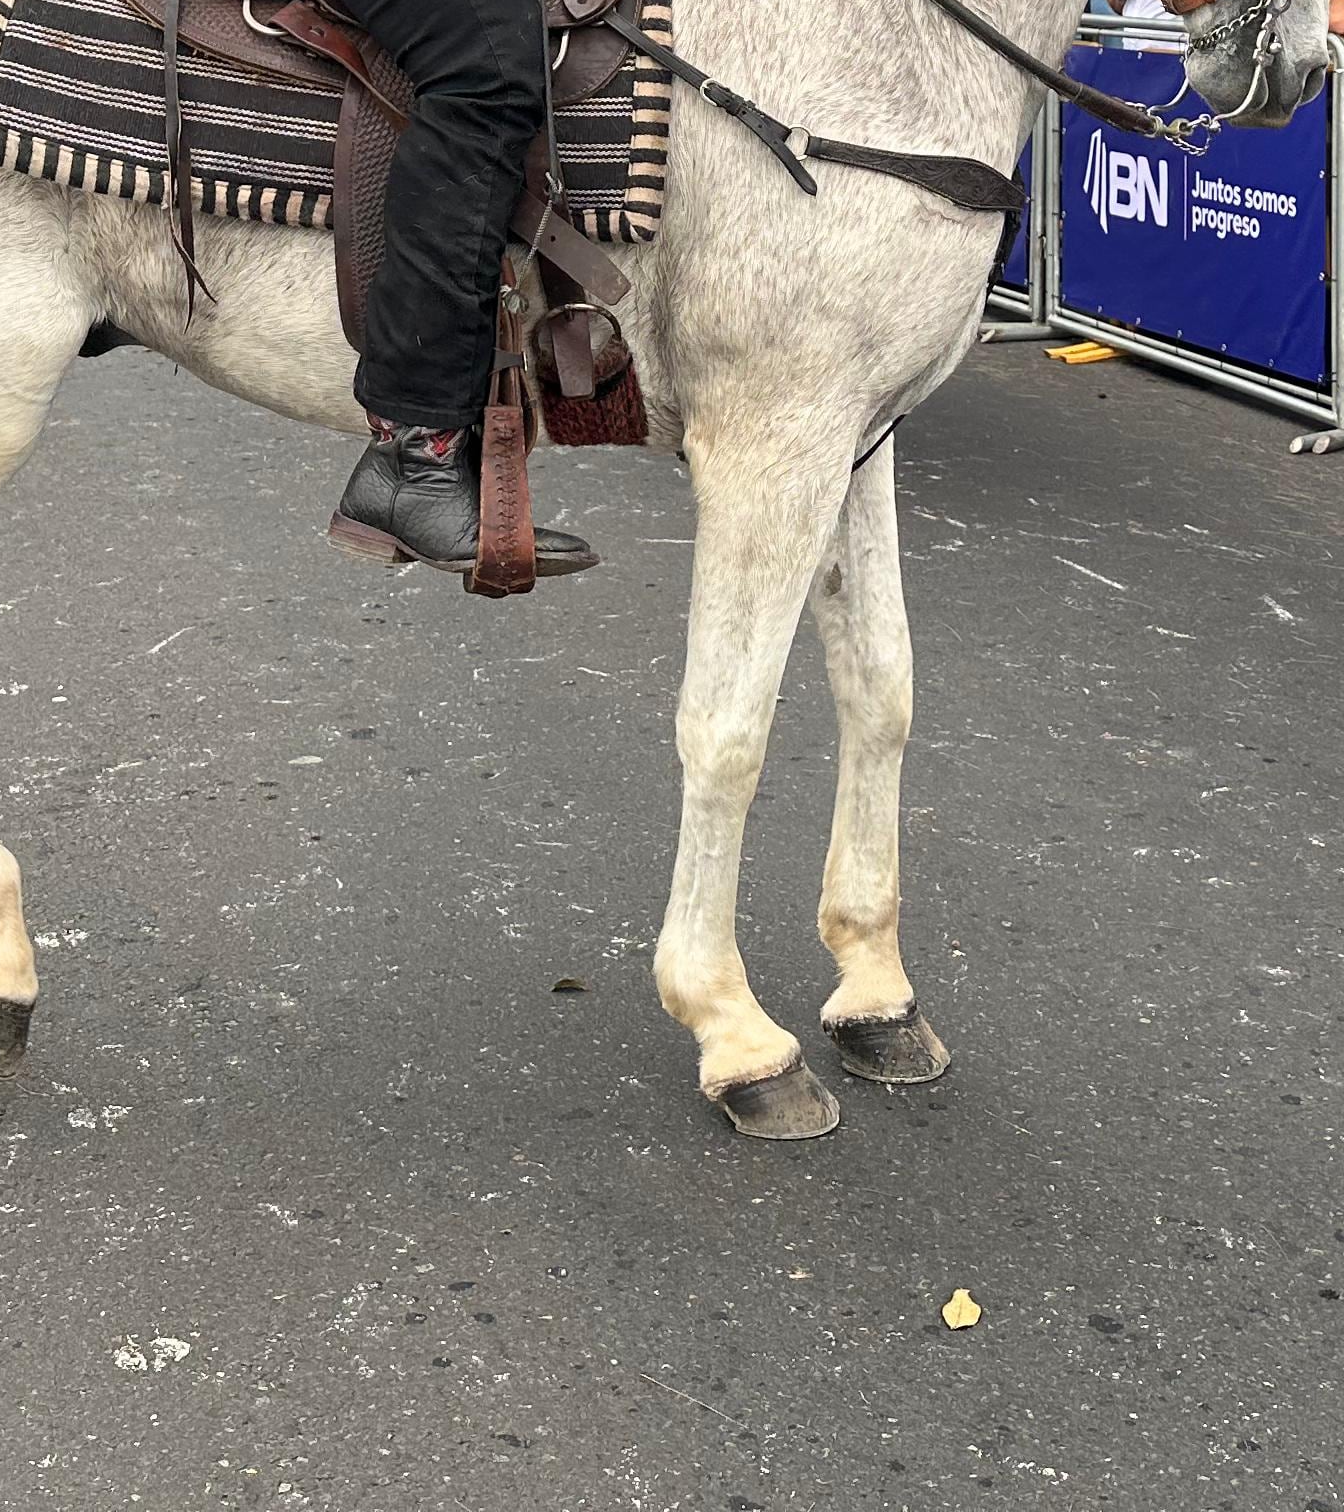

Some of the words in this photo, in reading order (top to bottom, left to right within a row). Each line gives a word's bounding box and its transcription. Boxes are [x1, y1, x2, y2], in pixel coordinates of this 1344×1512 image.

[1108, 150, 1169, 227] BN
[1191, 170, 1242, 206] Juntos
[1244, 188, 1297, 217] somos
[1191, 205, 1260, 239] progreso
